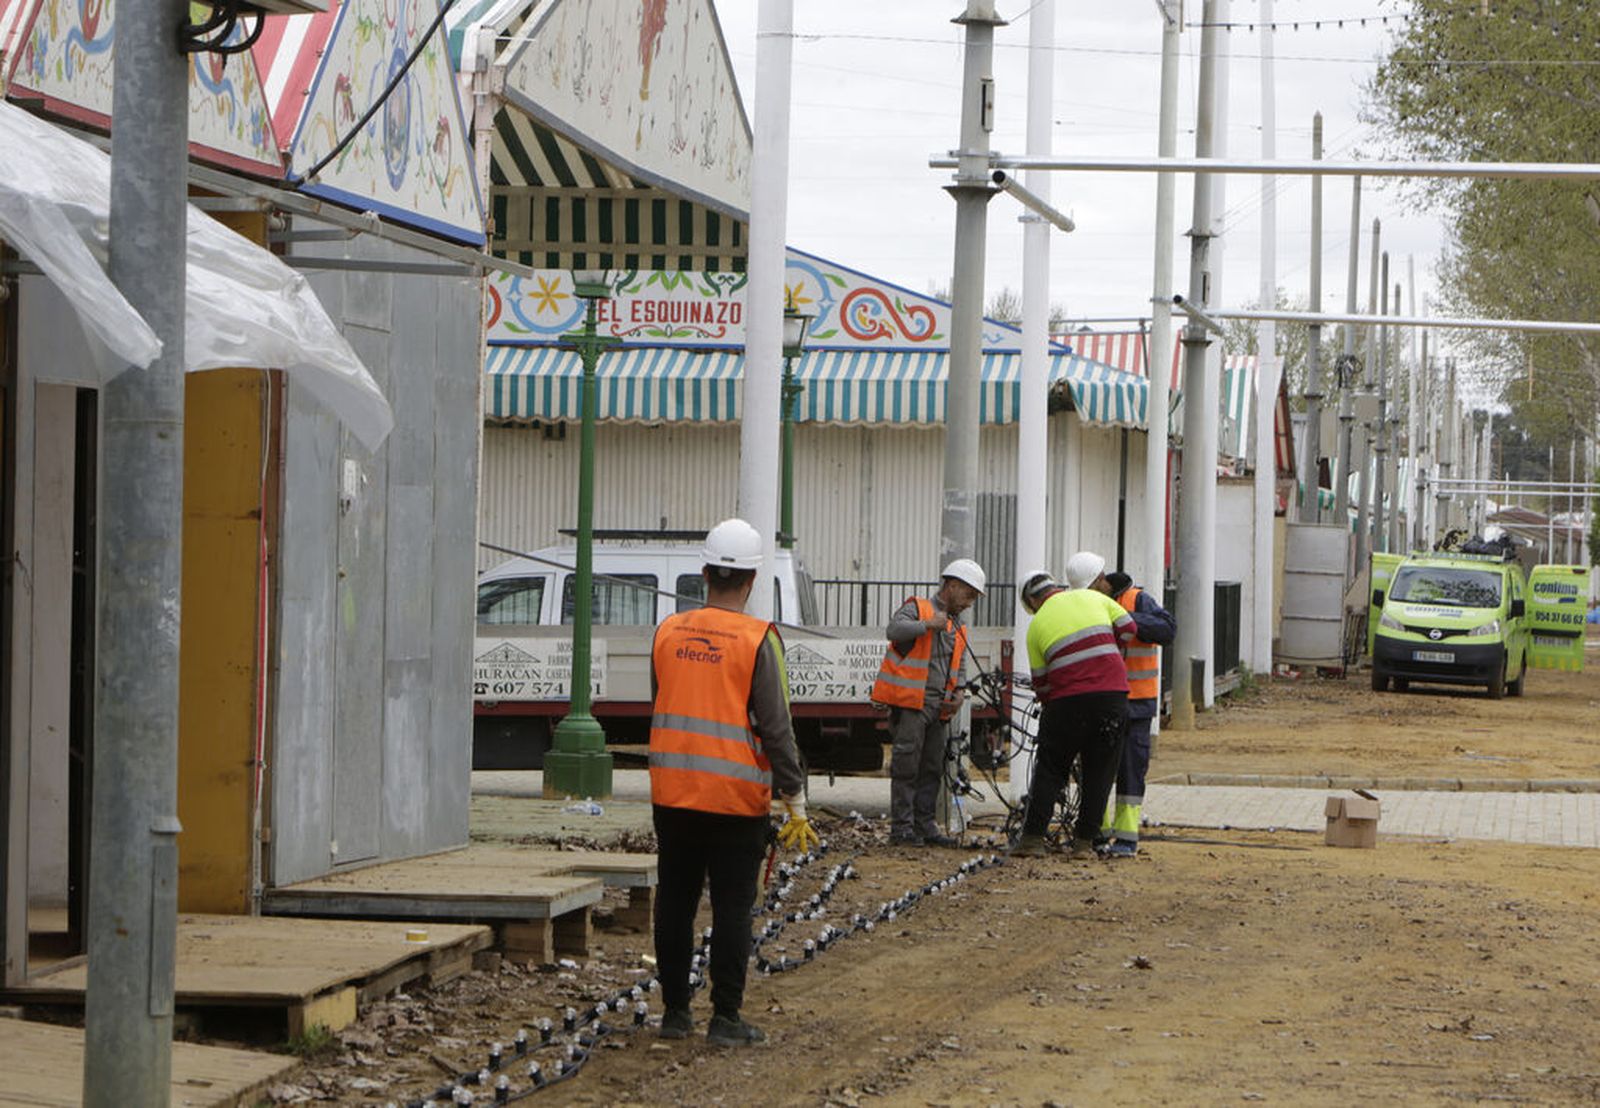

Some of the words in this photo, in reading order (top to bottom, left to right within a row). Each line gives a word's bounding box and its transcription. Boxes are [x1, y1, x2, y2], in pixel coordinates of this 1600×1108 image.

[598, 299, 622, 322] EL
[631, 300, 742, 324] ESQUINAZO
[676, 646, 723, 664] elecnor
[844, 644, 888, 657] ALQUILE
[475, 668, 541, 680] HURACAN
[786, 671, 834, 681] RACAN
[493, 682, 525, 695] 607
[532, 682, 563, 695] 574
[824, 683, 856, 697] 574
